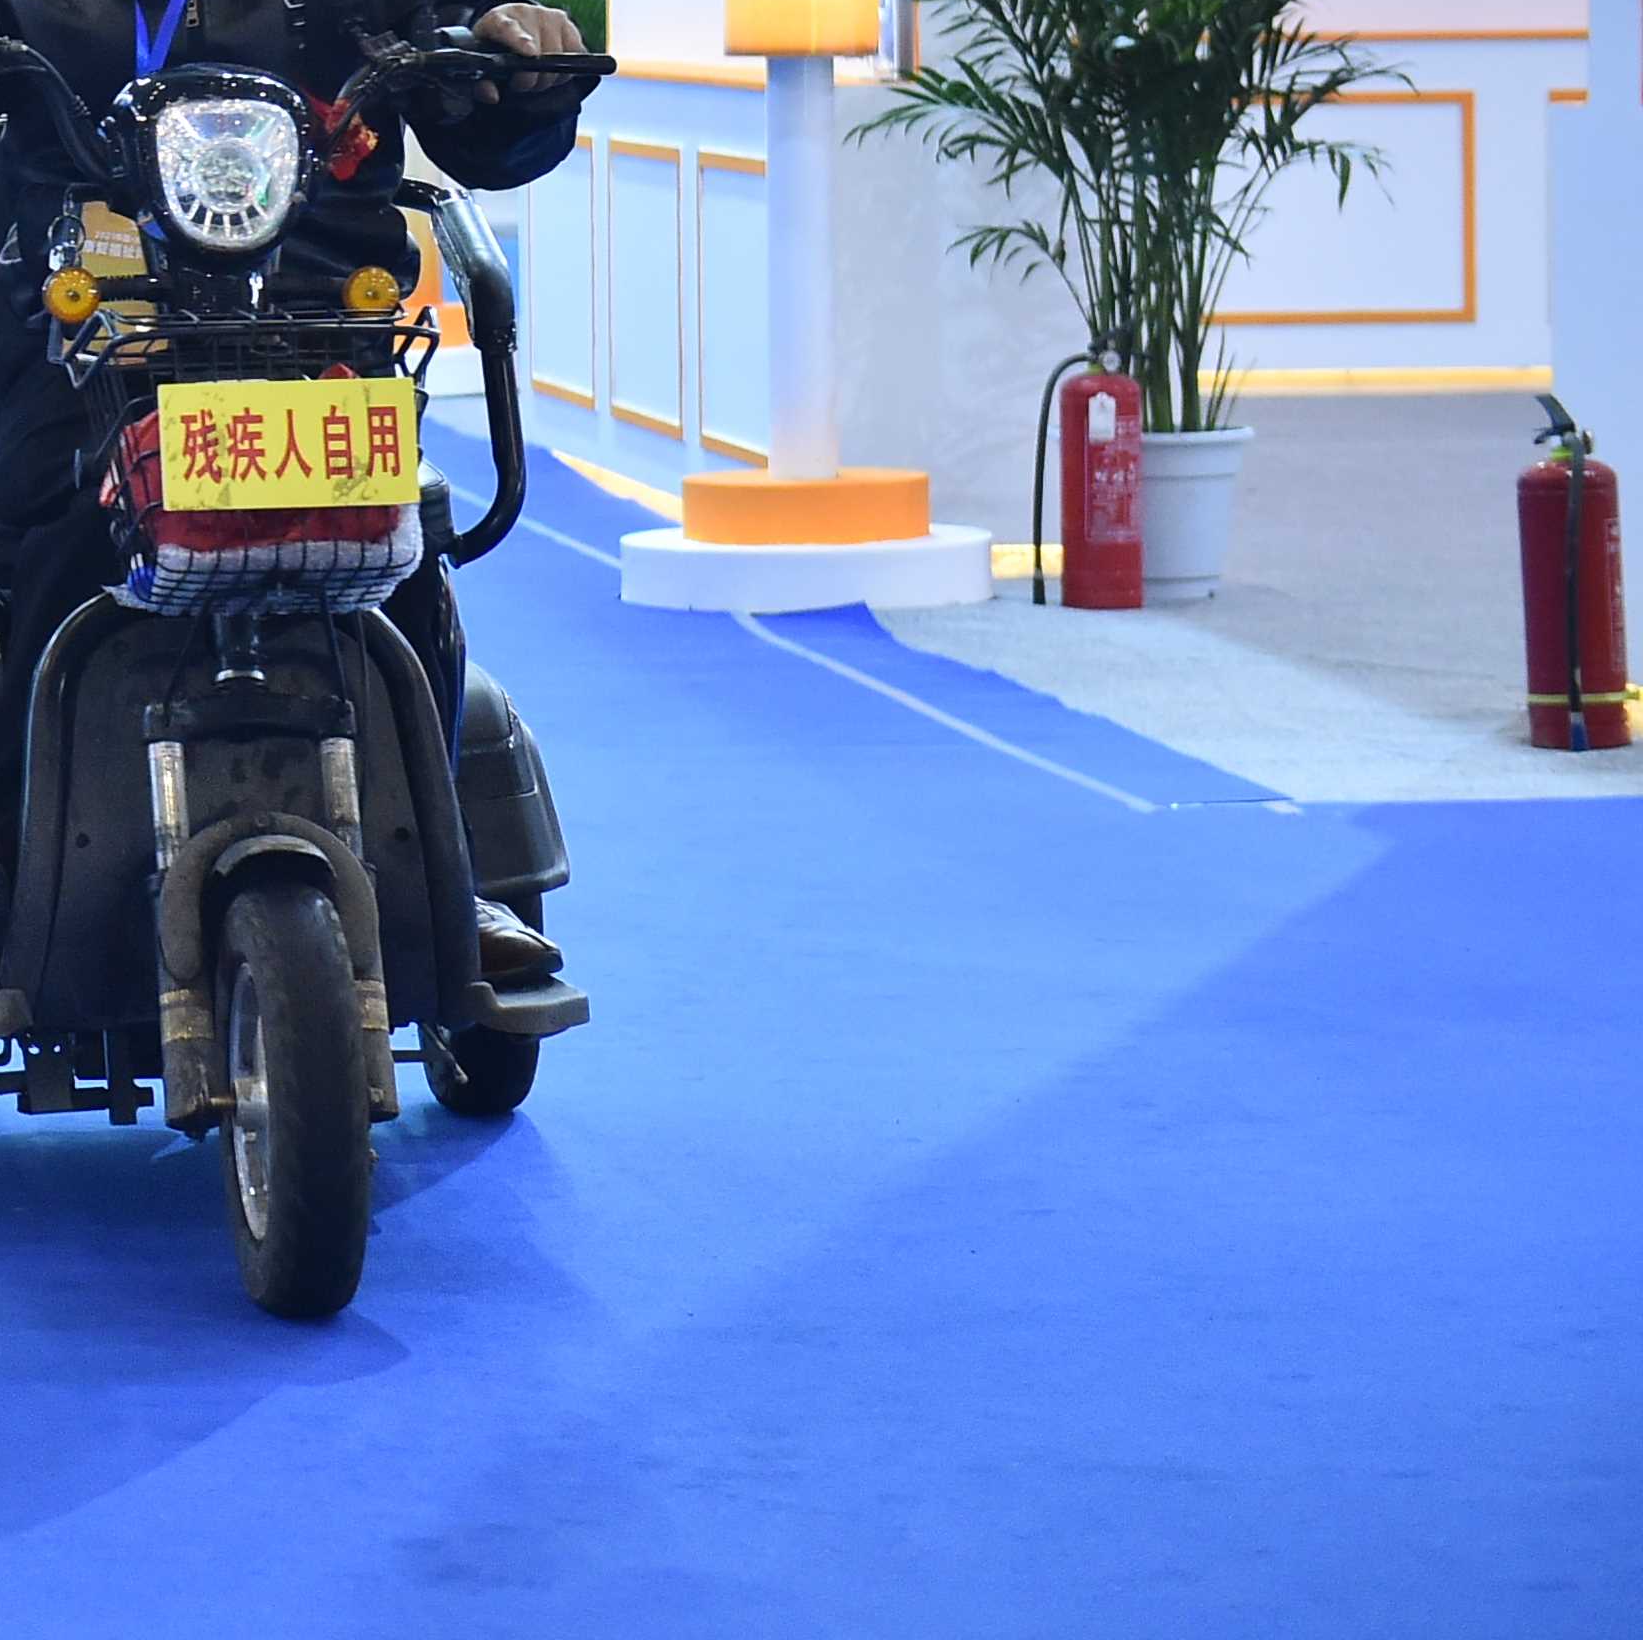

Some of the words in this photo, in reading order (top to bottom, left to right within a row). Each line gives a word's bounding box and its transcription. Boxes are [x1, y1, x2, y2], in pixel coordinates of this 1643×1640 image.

[179, 405, 401, 484] 残疾人自用
